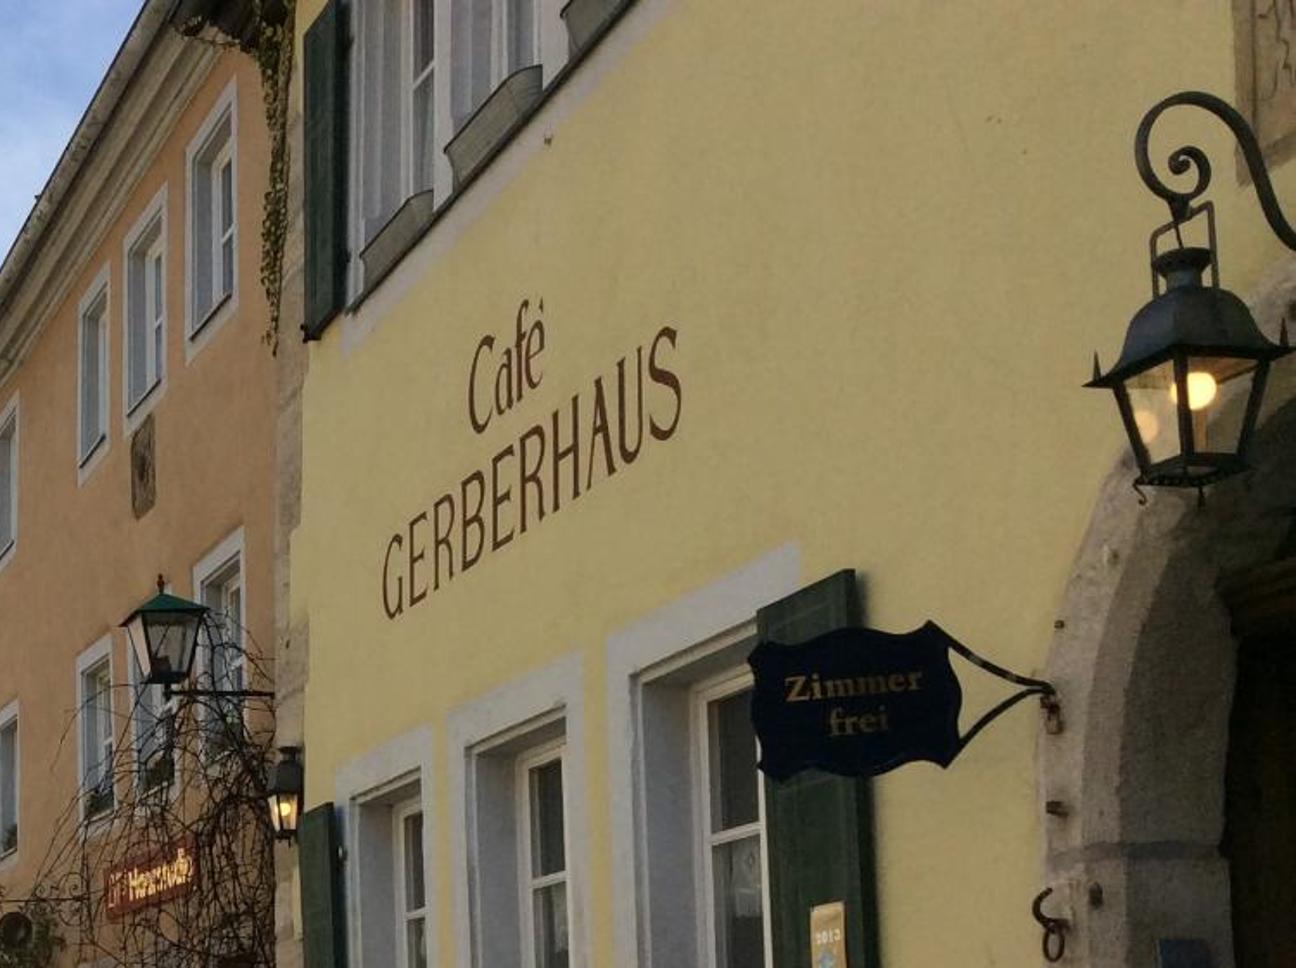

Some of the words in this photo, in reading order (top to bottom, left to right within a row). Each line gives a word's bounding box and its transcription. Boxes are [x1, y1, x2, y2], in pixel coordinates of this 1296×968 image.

[468, 297, 546, 434] Café
[382, 326, 682, 620] GERBERHAUS
[784, 671, 923, 702] Zimmer
[829, 704, 889, 736] frei
